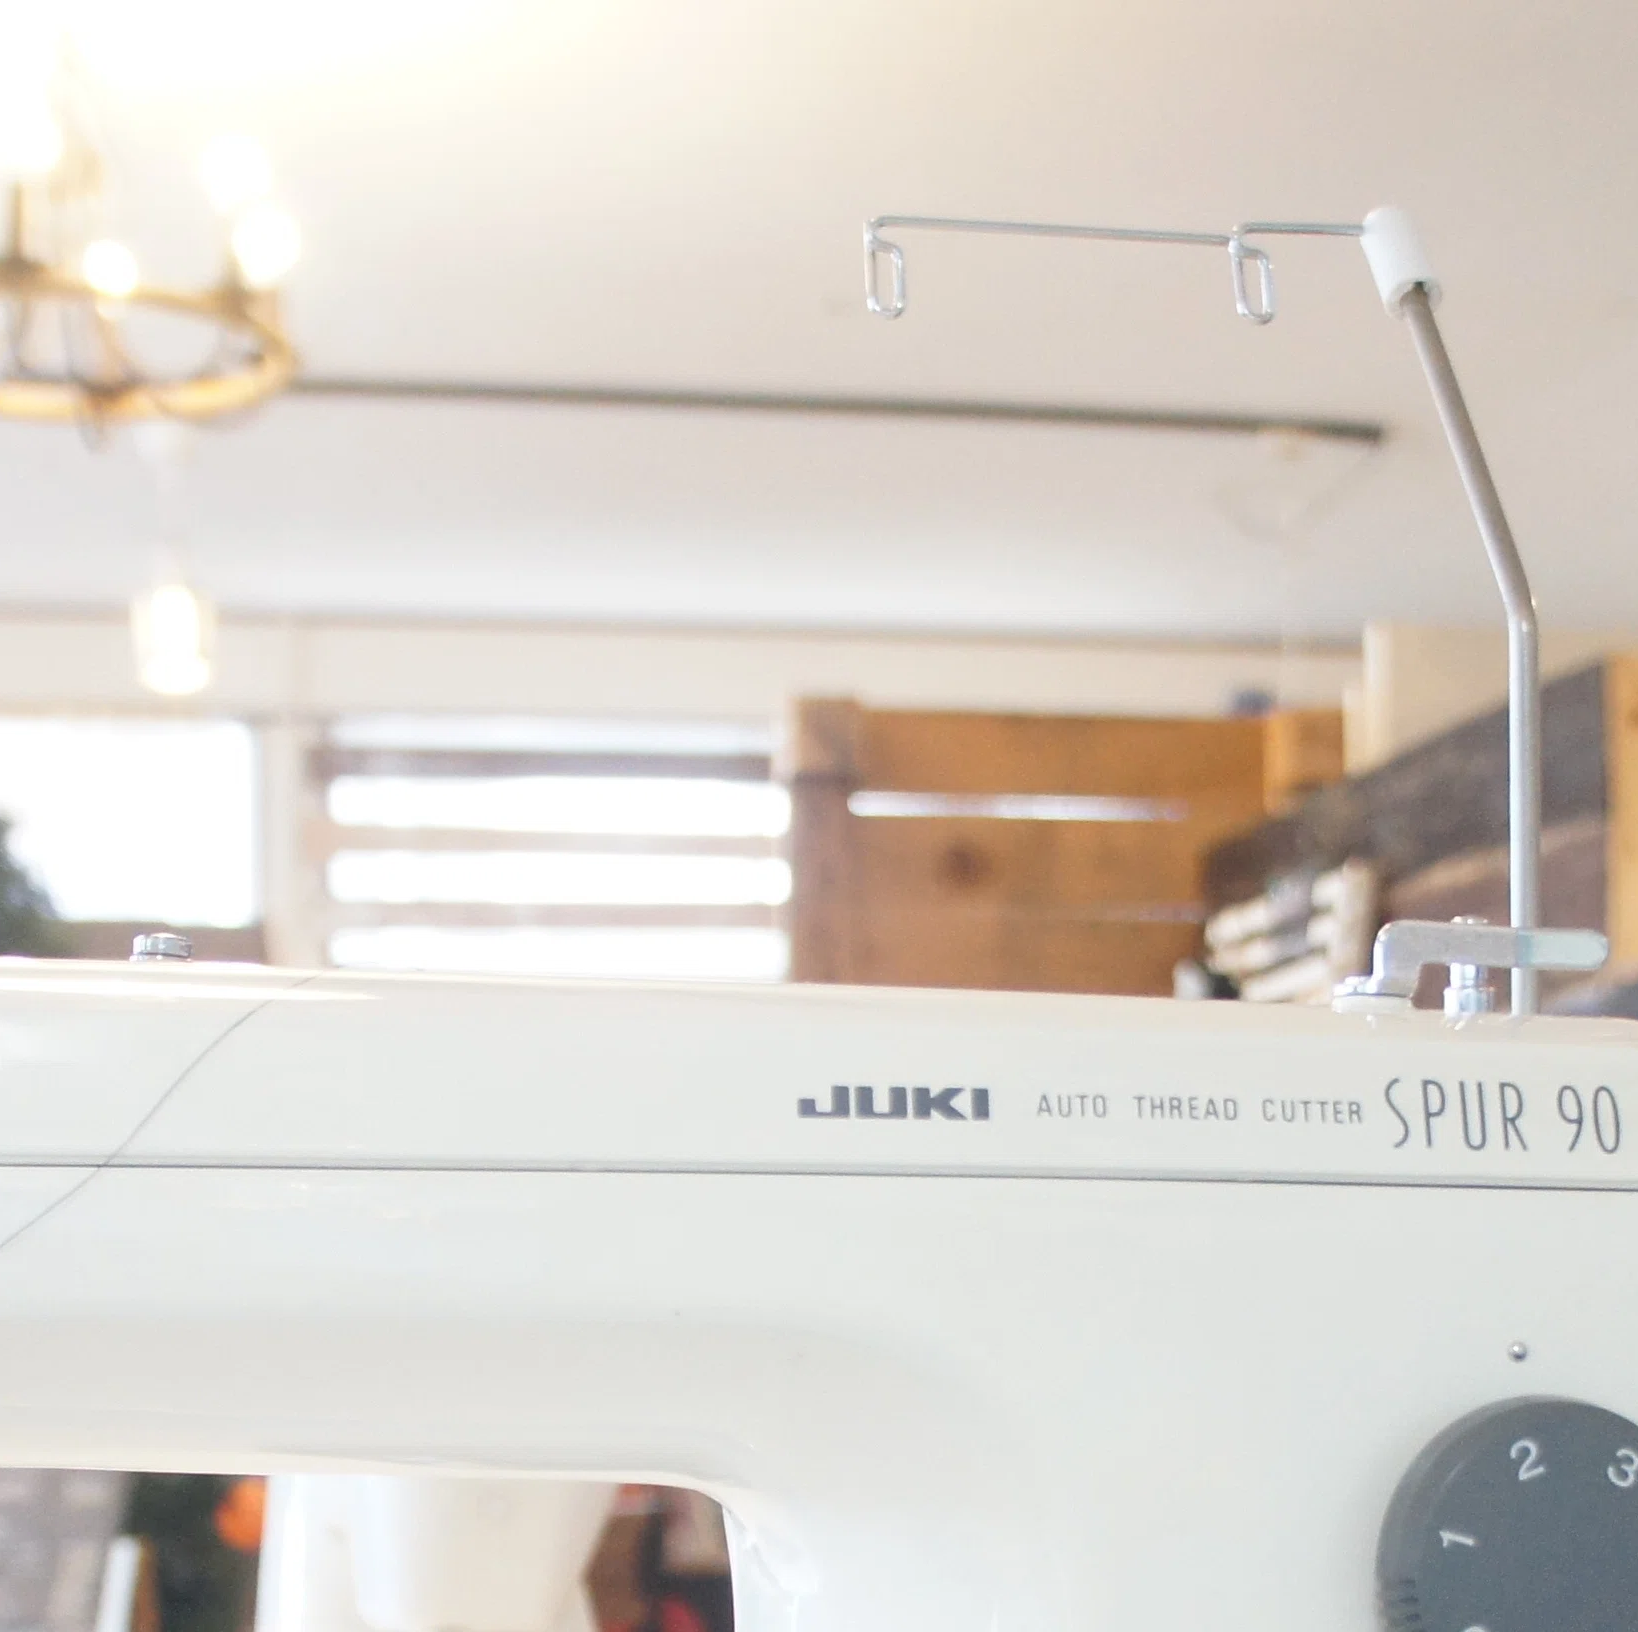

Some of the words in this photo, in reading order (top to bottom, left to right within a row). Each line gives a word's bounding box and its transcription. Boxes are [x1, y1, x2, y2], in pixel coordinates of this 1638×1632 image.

[797, 1084, 990, 1120] JUKI
[1036, 1094, 1108, 1118] AUTO
[1132, 1096, 1239, 1121] THREAD
[1261, 1098, 1363, 1124] CUTTER
[1383, 1077, 1529, 1151] SPUR
[1556, 1084, 1621, 1154] 90
[1509, 1438, 1547, 1482] 2
[1438, 1528, 1476, 1550] 1
